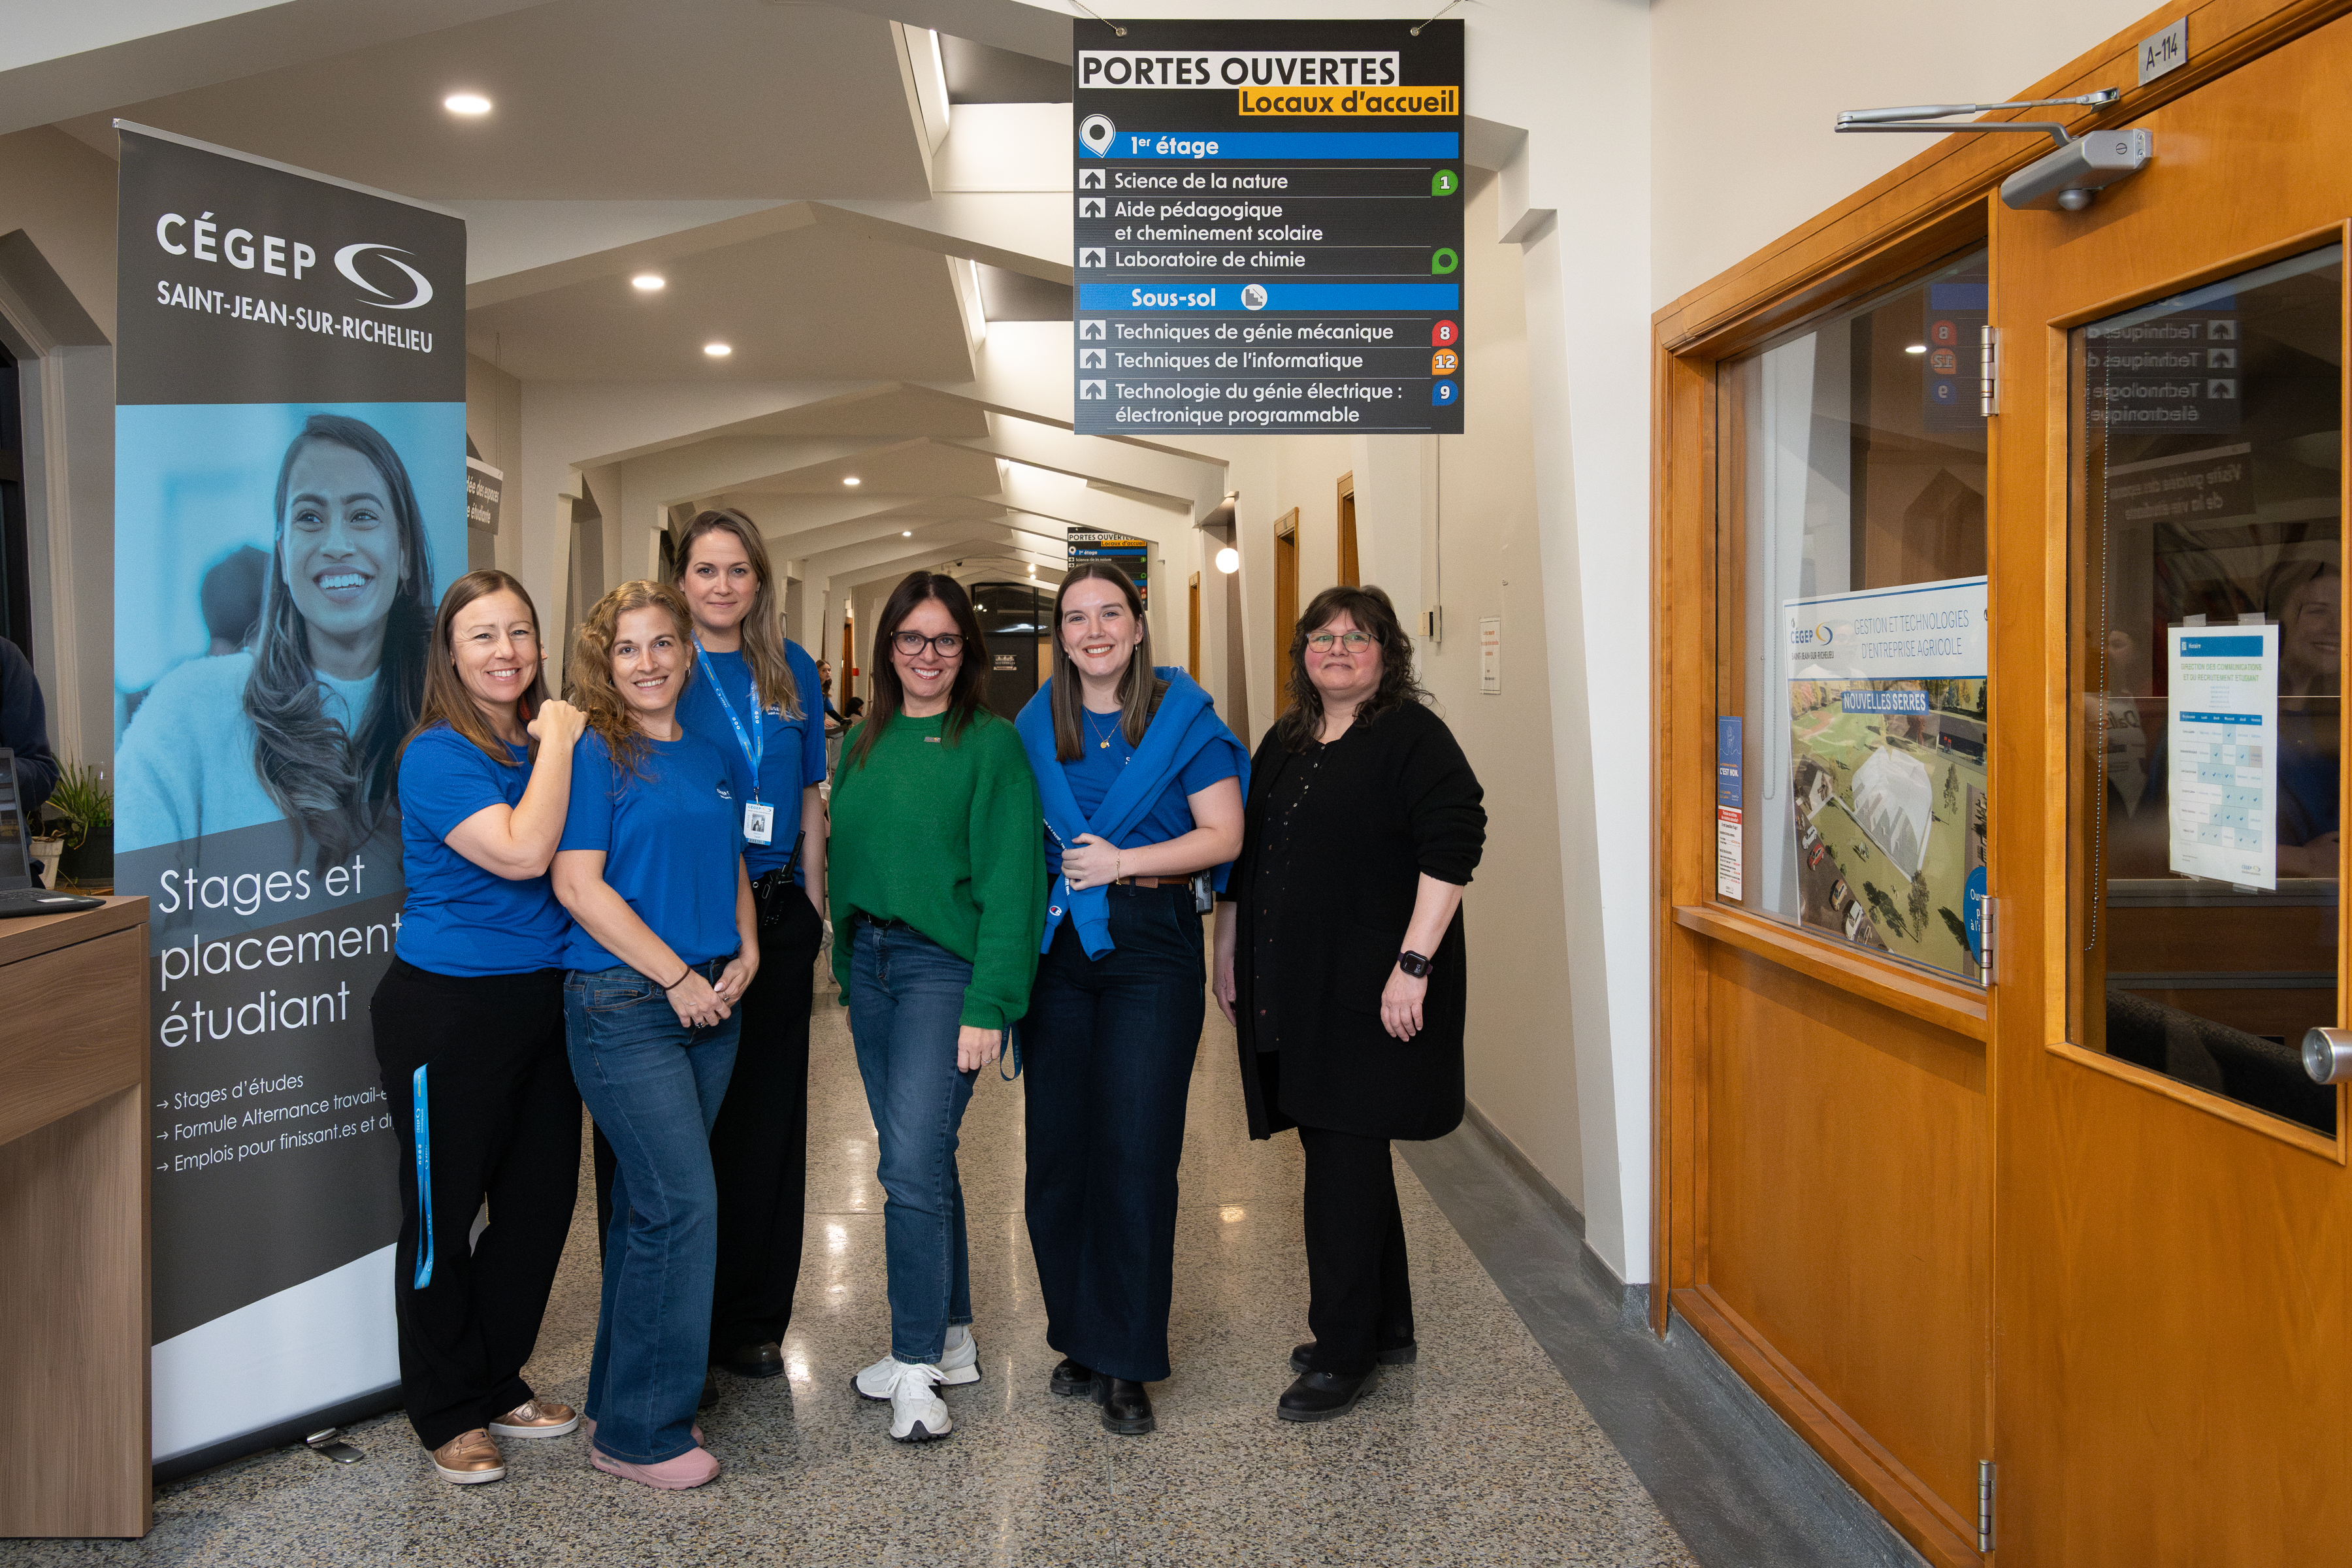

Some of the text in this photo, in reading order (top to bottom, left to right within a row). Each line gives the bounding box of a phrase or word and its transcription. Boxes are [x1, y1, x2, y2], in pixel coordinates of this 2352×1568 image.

[2146, 33, 2178, 71] A-114
[1083, 57, 1396, 86] PORTES OUVERTES
[1242, 90, 1455, 113] Locaux d'accueil
[1131, 136, 1219, 159] 1er étage
[1115, 172, 1288, 189] Science de la nature
[1439, 176, 1450, 189] 1
[1115, 201, 1283, 221] Aide pédagogique
[1115, 225, 1323, 241] et cheminement scolaire
[157, 211, 316, 280] CÉGEP
[1116, 251, 1305, 267] Laboratoire de chimie
[1132, 288, 1216, 307] Sous-sol
[157, 280, 433, 353] SAINT-JEAN-SUR-RICHELIEU
[1115, 323, 1394, 343] Techniques de génie mécanique
[1439, 326, 1450, 340] 8
[1115, 351, 1364, 371] Techniques de l'informatique
[1434, 355, 1456, 368] 12
[1115, 382, 1221, 402] Technologie
[1226, 382, 1249, 399] du
[1252, 383, 1303, 402] génie
[1307, 382, 1394, 402] électrique
[1439, 385, 1450, 400] 9
[1116, 406, 1360, 426] électronique programmable
[1854, 610, 1969, 635] GESTION ET TECHNOLOGIES
[1791, 628, 1813, 644] CÉGEP
[1791, 651, 1835, 660] SAINT-JEAN-SUR-RICHELIEU
[1862, 638, 1963, 659] D'ENTREPRISE AGRICOLE
[1844, 693, 1926, 711] NOUVELLES SERRES
[159, 855, 365, 915] Stages et
[161, 913, 402, 991] placement
[160, 981, 350, 1047] étudiant
[174, 1074, 303, 1109] Stages d'études
[175, 1114, 237, 1141] Formule
[242, 1100, 329, 1127] Alternance
[175, 1144, 233, 1171] Emplois
[238, 1139, 276, 1162] pour
[280, 1123, 357, 1150] finissant.es
[361, 1116, 375, 1134] et
